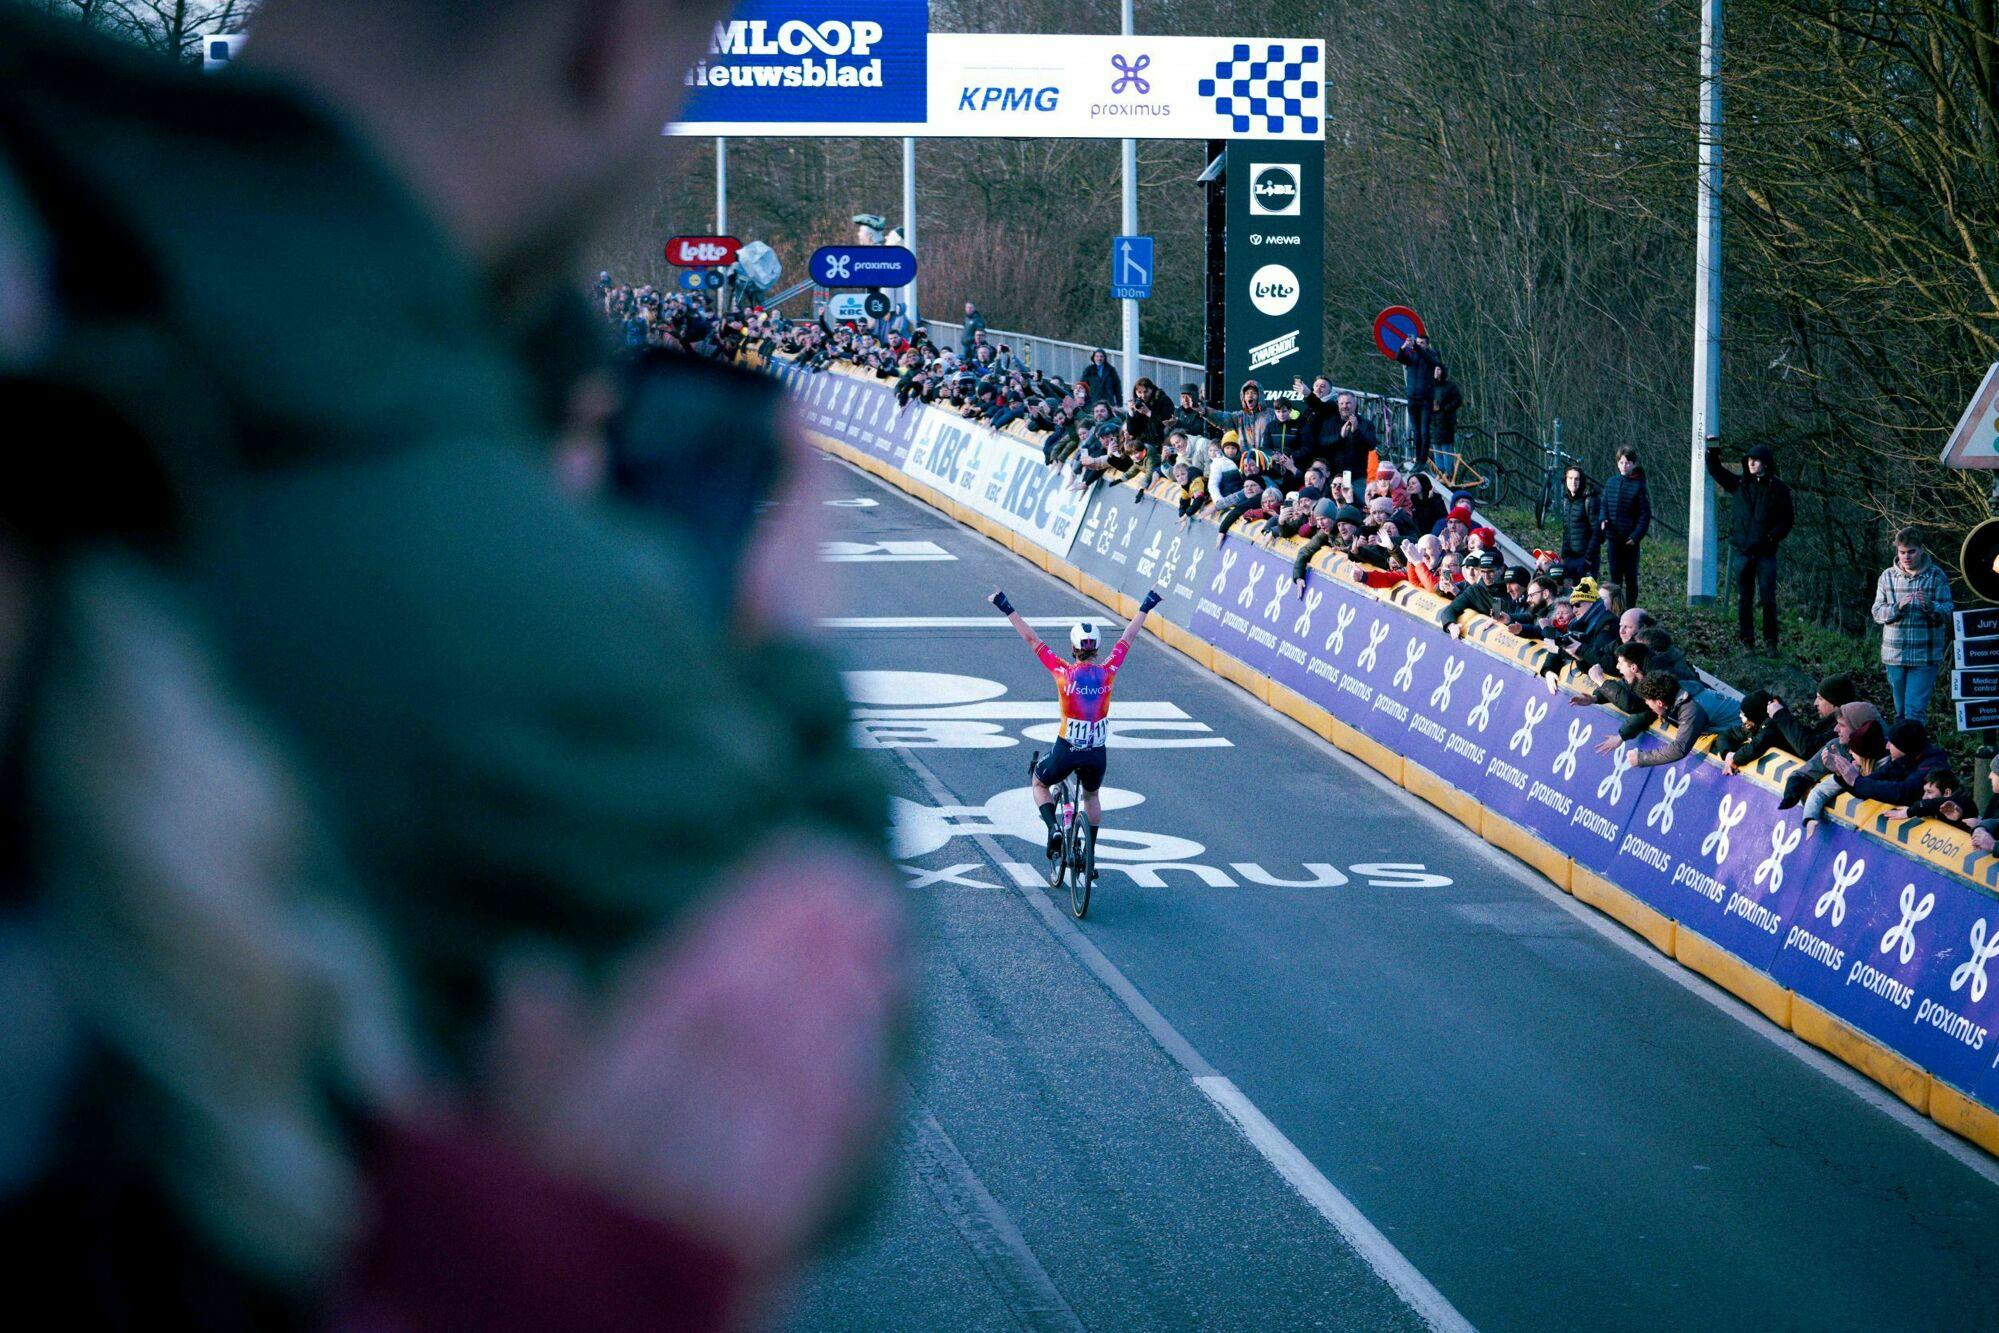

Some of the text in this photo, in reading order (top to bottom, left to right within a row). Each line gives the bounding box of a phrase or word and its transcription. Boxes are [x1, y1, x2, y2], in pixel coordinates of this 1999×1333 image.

[707, 20, 882, 56] MLOOP
[958, 86, 1059, 112] KPMG
[1090, 103, 1171, 119] proximus
[854, 260, 902, 271] proximus
[1116, 288, 1145, 298] 100m
[840, 308, 863, 316] KBC
[925, 423, 972, 485] KBC
[984, 481, 1003, 504] KBC
[1001, 456, 1065, 530] KBC
[1051, 515, 1071, 540] KBC
[1977, 619, 1998, 629] Jury
[1068, 721, 1087, 740] 111
[1196, 596, 1989, 1051] proximus proximus proximus proximus proximus proximus proximus proximus proximus proximus proximus proximus proximus proximus proximus proximus proximus proximus
[1920, 828, 1960, 858] boplan
[898, 862, 1454, 889] ximus
